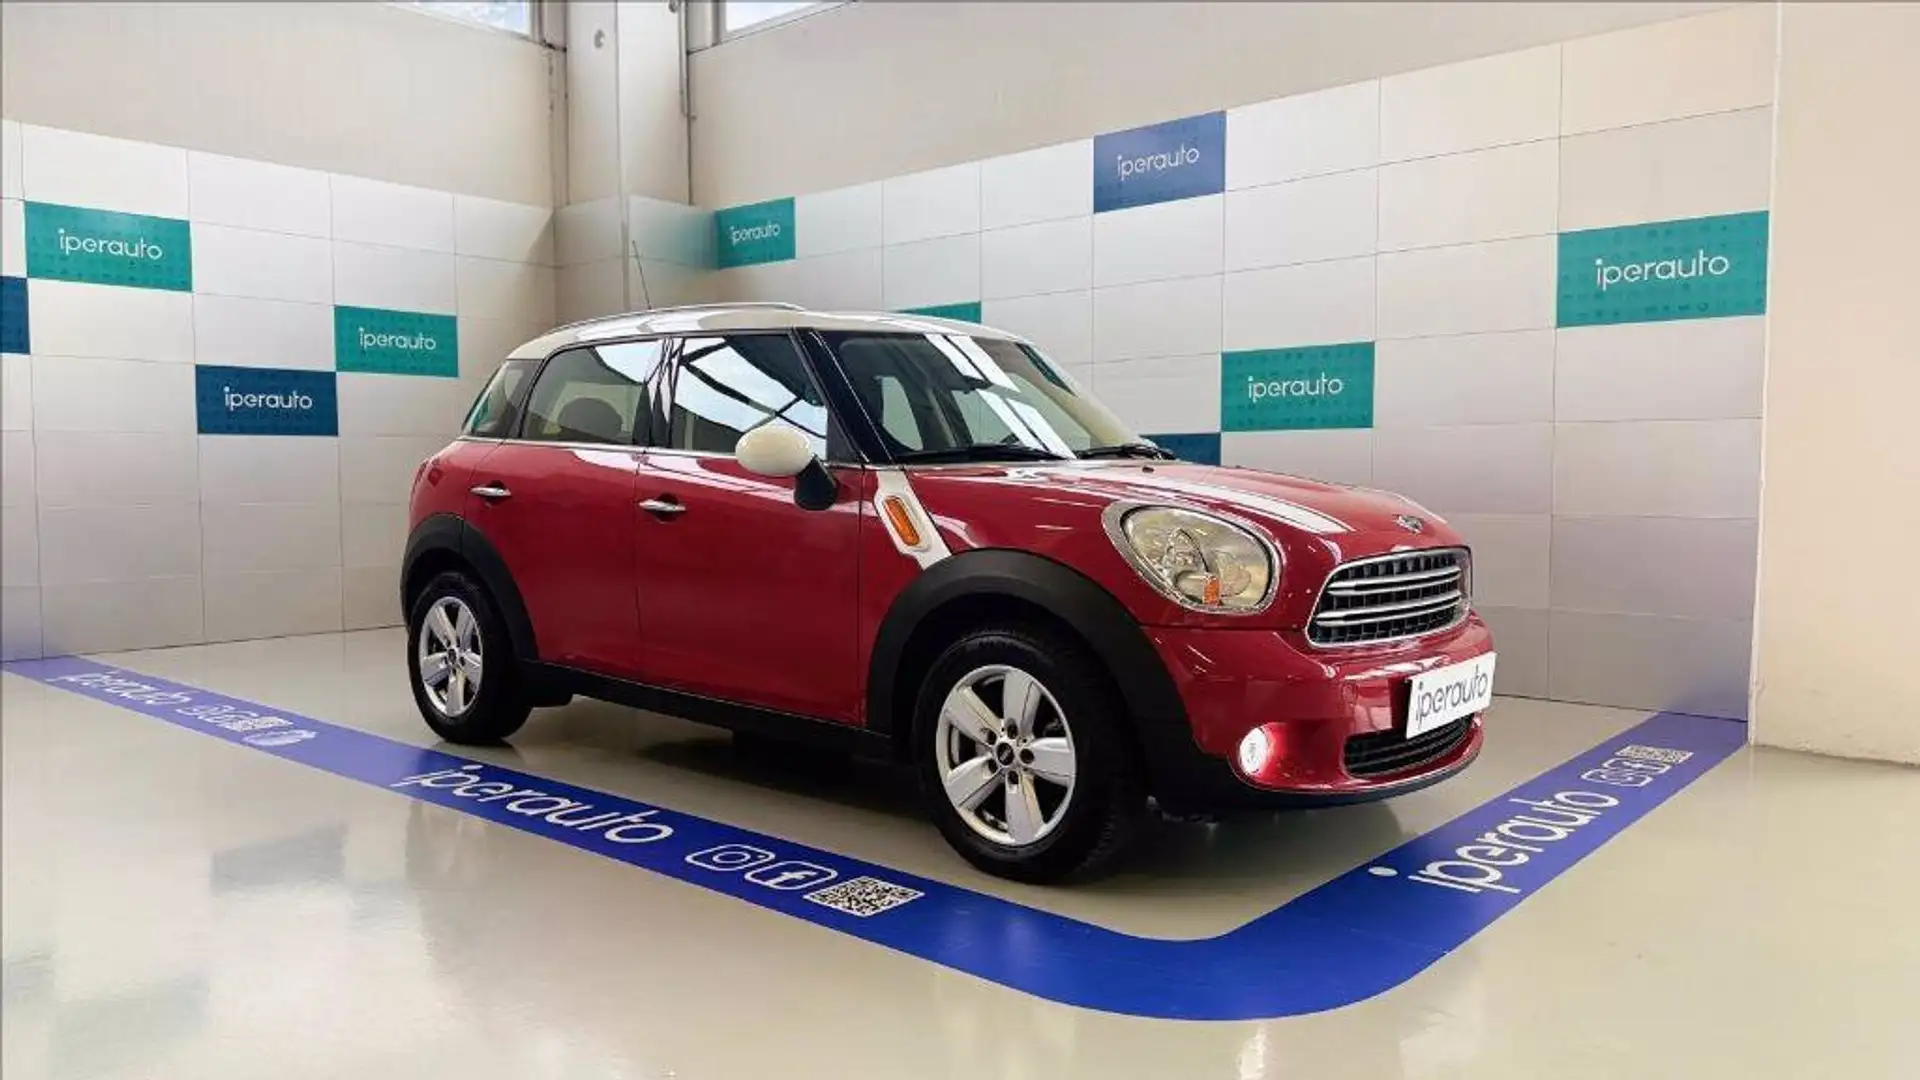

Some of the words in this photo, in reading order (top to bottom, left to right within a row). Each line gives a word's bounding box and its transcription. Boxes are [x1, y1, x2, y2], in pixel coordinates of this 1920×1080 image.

[1117, 144, 1201, 181] iperauto
[57, 228, 163, 261] iperauto
[1595, 249, 1731, 291] iperauto
[357, 326, 437, 350] iperauto
[223, 386, 313, 411] iperauto
[1247, 372, 1344, 402] iperauto
[1414, 664, 1488, 729] iperauto
[391, 764, 673, 844] iperauto
[1368, 791, 1620, 893] iperauto
